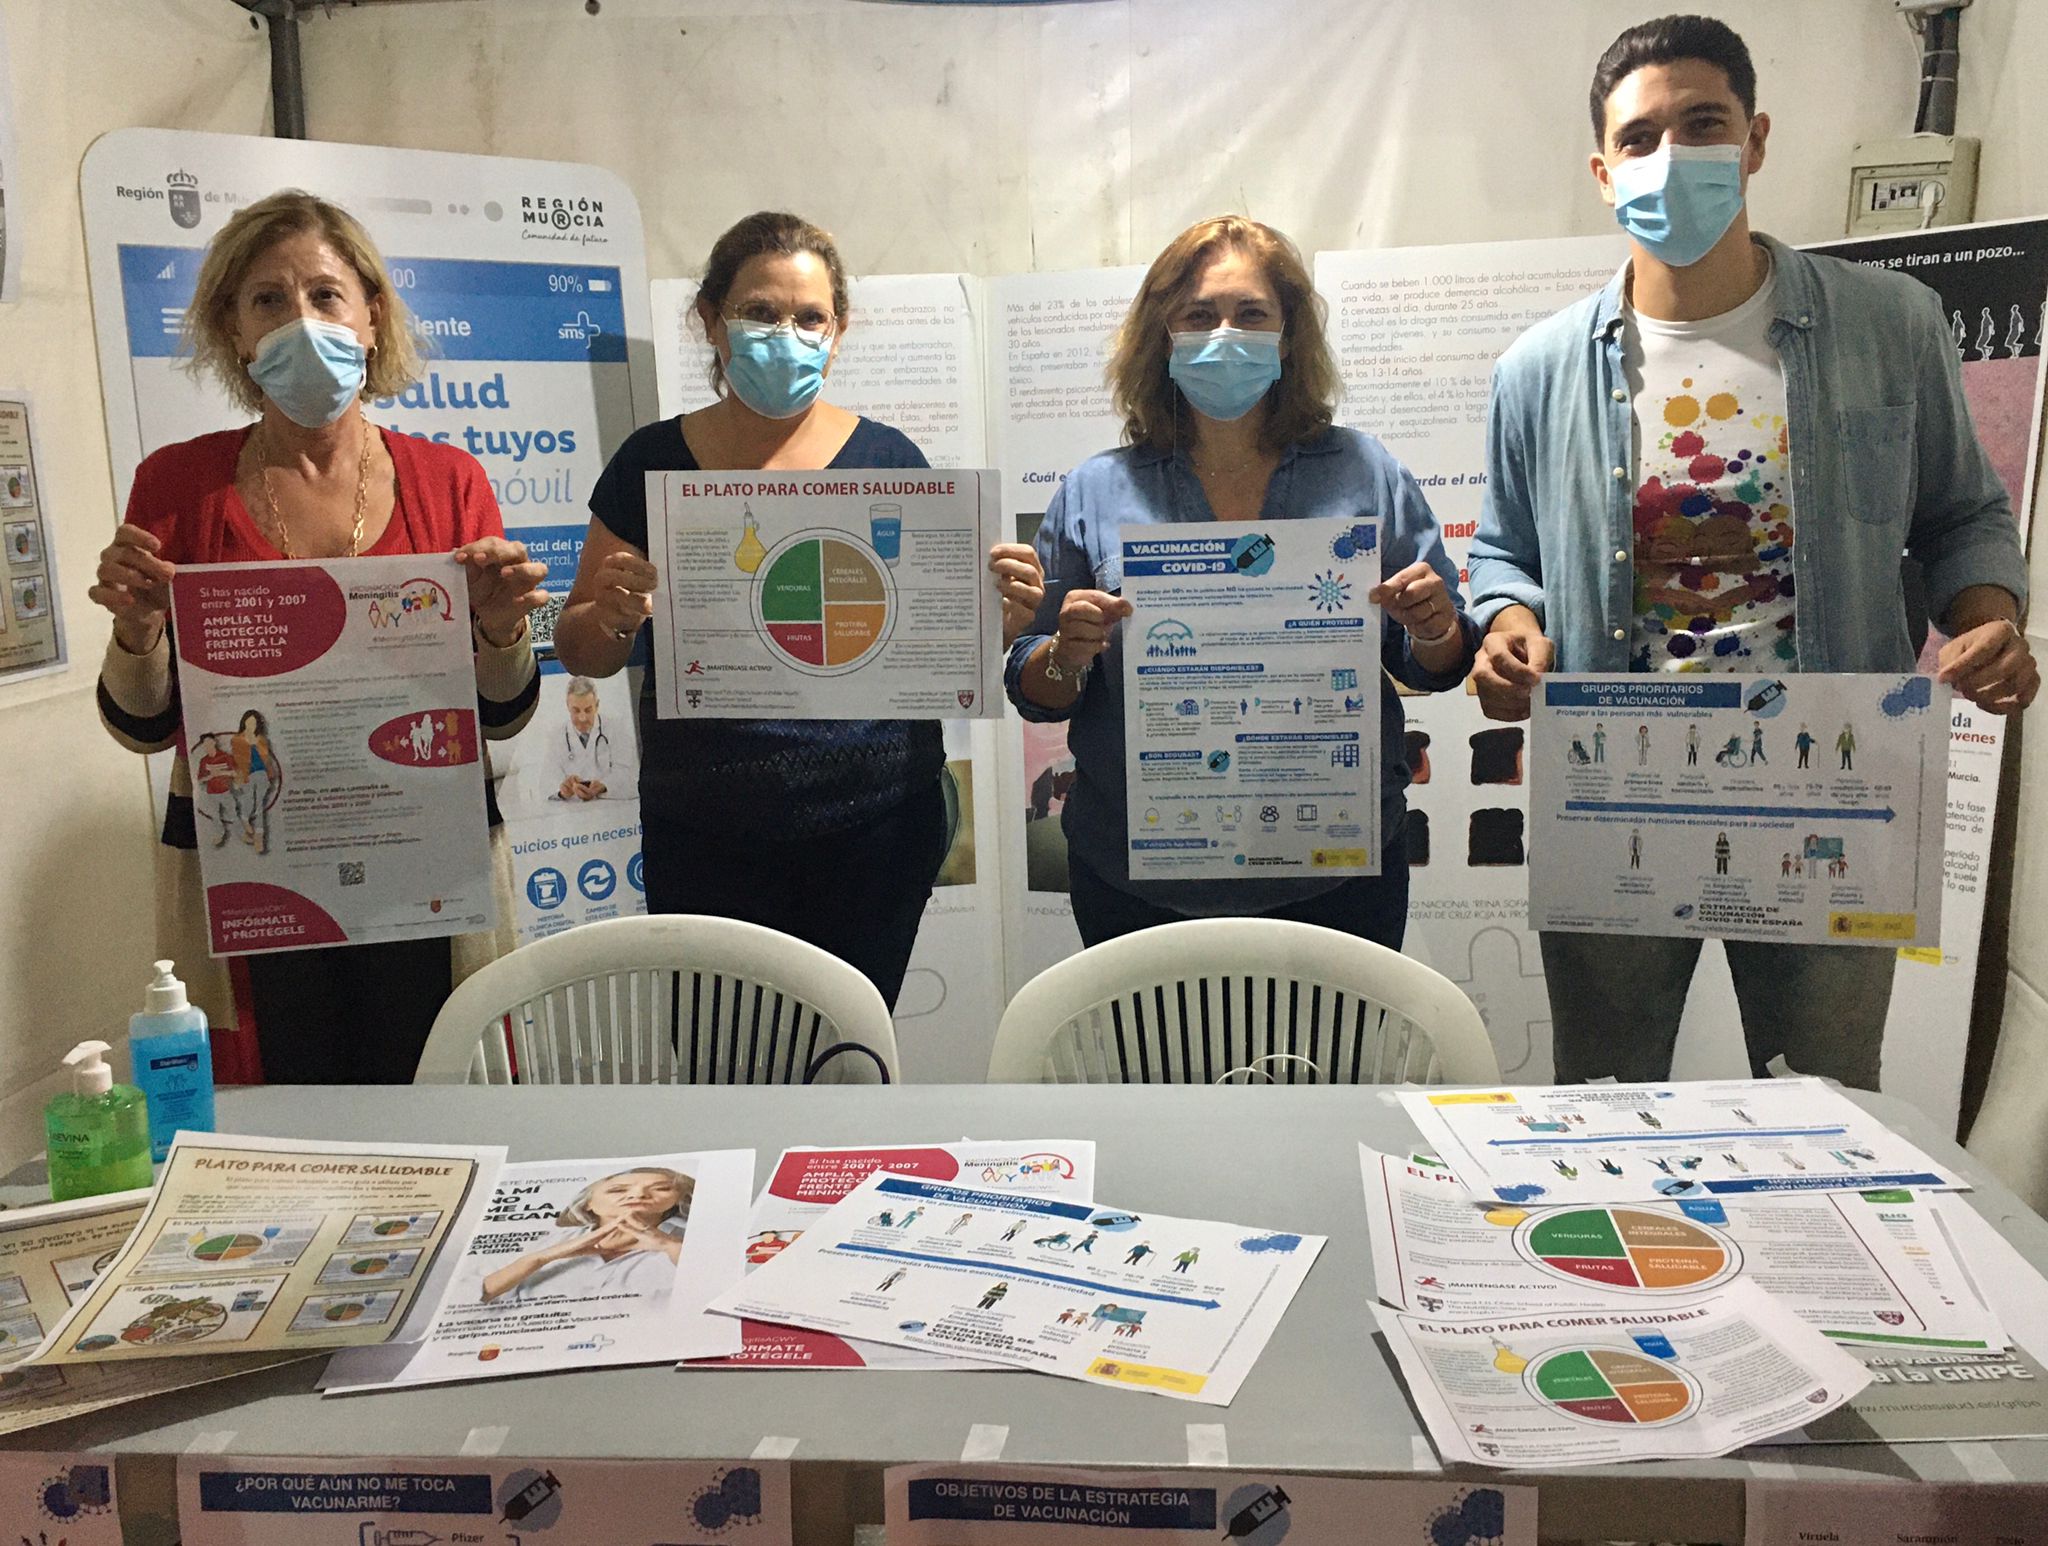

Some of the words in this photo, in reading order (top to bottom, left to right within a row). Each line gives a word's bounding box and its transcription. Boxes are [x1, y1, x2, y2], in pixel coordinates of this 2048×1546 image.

[116, 185, 164, 200] Región
[522, 196, 603, 212] REGIÓN
[523, 208, 604, 230] MURCIA
[1888, 257, 1903, 269] se
[1906, 254, 1940, 267] tiran
[1943, 252, 1952, 263] a
[1955, 250, 1972, 262] un
[1976, 246, 2025, 263] pozo...
[548, 274, 583, 293] 90%
[1351, 305, 1390, 316] cervezas
[1392, 303, 1400, 313] al
[1424, 300, 1458, 312] durante
[1461, 300, 1473, 309] 25
[1008, 340, 1020, 349] 30
[1022, 340, 1040, 348] años
[463, 426, 576, 461] tuyos
[1022, 472, 1055, 484] ¿Cuál
[682, 483, 700, 497] EL
[704, 483, 753, 497] PLATO
[757, 483, 798, 496] PARA
[802, 482, 859, 496] COMER
[862, 481, 955, 495] SALUDABLE
[1130, 540, 1225, 555] VACUNACIÓN
[1161, 561, 1226, 573] COVID-19
[199, 587, 210, 598] Si
[212, 587, 231, 597] has
[234, 586, 270, 596] nacido
[202, 600, 231, 609] entre
[234, 598, 262, 608] 2001
[279, 595, 306, 606] 2007
[203, 615, 250, 627] AMPLÍA
[253, 613, 273, 623] TU
[205, 624, 289, 638] PROTECCIÓN
[205, 638, 256, 650] FRENTE
[260, 638, 268, 647] A
[270, 636, 287, 646] LA
[207, 648, 282, 661] MENINGITIS
[1581, 683, 1626, 695] GRUPOS
[1627, 683, 1704, 695] PRIORITARIOS
[1598, 695, 1613, 706] DE
[1615, 694, 1686, 706] VACUNACIÓN
[1952, 713, 1972, 728] da
[1967, 800, 1986, 813] fase
[1971, 824, 1983, 833] de
[1945, 860, 1979, 871] alcohol
[1954, 871, 1978, 883] suele
[1958, 883, 1976, 893] que
[222, 914, 297, 930] INFÓRMATE
[232, 925, 305, 940] PROTÉGELE
[194, 1158, 250, 1171] PLATO
[251, 1161, 296, 1172] PARA
[300, 1162, 358, 1174] COMER
[360, 1164, 453, 1176] SALUDABLE
[803, 1170, 855, 1178] AMPLÍA
[1406, 1166, 1432, 1180] EL
[920, 1184, 969, 1196] GRUPOS
[970, 1189, 1052, 1207] PRIORITARIOS
[951, 1194, 1029, 1210] VACUNACIÓN
[524, 1203, 554, 1211] LA
[1550, 1232, 1604, 1241] VERDURAS
[1574, 1262, 1615, 1271] FRUTAS
[456, 1316, 501, 1327] vacuna
[1418, 1322, 1440, 1334] EL
[1440, 1324, 1495, 1336] PLATO
[1498, 1319, 1544, 1334] PARA
[1547, 1317, 1607, 1331] COMER
[1609, 1308, 1710, 1327] SALUDABLE
[1892, 1367, 1930, 1382] la
[1933, 1364, 2035, 1381] GRIPE
[234, 1475, 278, 1492] ¿POR
[281, 1474, 316, 1492] QUÉ
[319, 1474, 352, 1492] AÚN
[356, 1476, 381, 1491] NO
[384, 1477, 408, 1492] ME
[413, 1478, 456, 1492] TOCA
[935, 1482, 1027, 1499] OBJETIVOS
[1031, 1486, 1055, 1501] DE
[1058, 1488, 1081, 1501] LA
[1085, 1488, 1190, 1506] ESTRATEGIA
[291, 1495, 400, 1510] VACUNARME?
[993, 1504, 1017, 1519] DE
[1020, 1504, 1131, 1524] VACUNACIÓN
[450, 1531, 486, 1544] Pfizer
